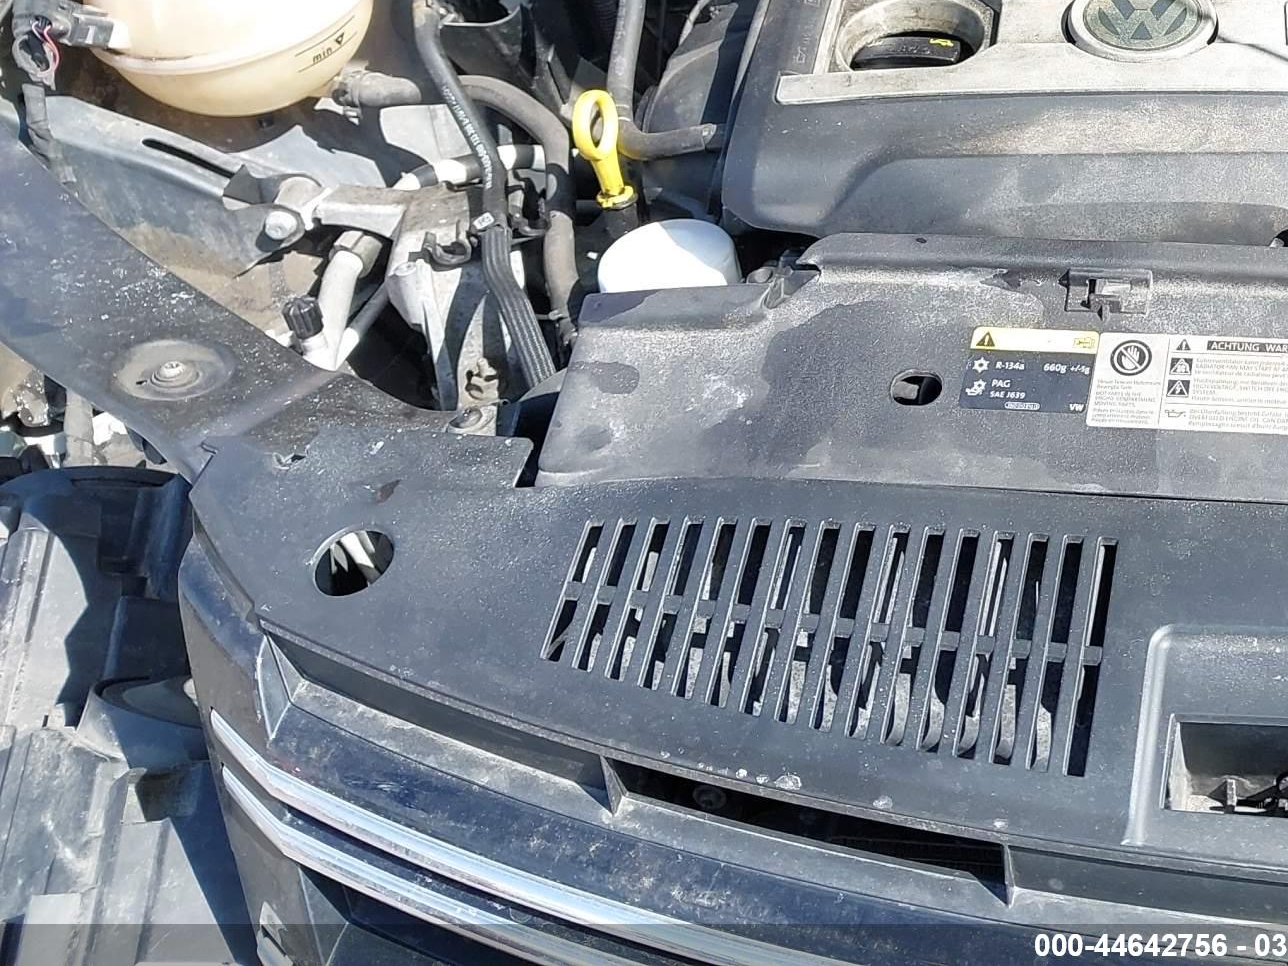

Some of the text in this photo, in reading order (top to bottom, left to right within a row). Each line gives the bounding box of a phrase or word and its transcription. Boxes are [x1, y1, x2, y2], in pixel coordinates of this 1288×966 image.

[312, 46, 333, 64] min
[1211, 341, 1260, 352] ACHTUNG
[995, 361, 1025, 370] R-134a
[1043, 363, 1067, 374] 660g
[991, 379, 1011, 388] PAG
[989, 391, 1026, 400] SAE J639
[1069, 403, 1085, 412] VW
